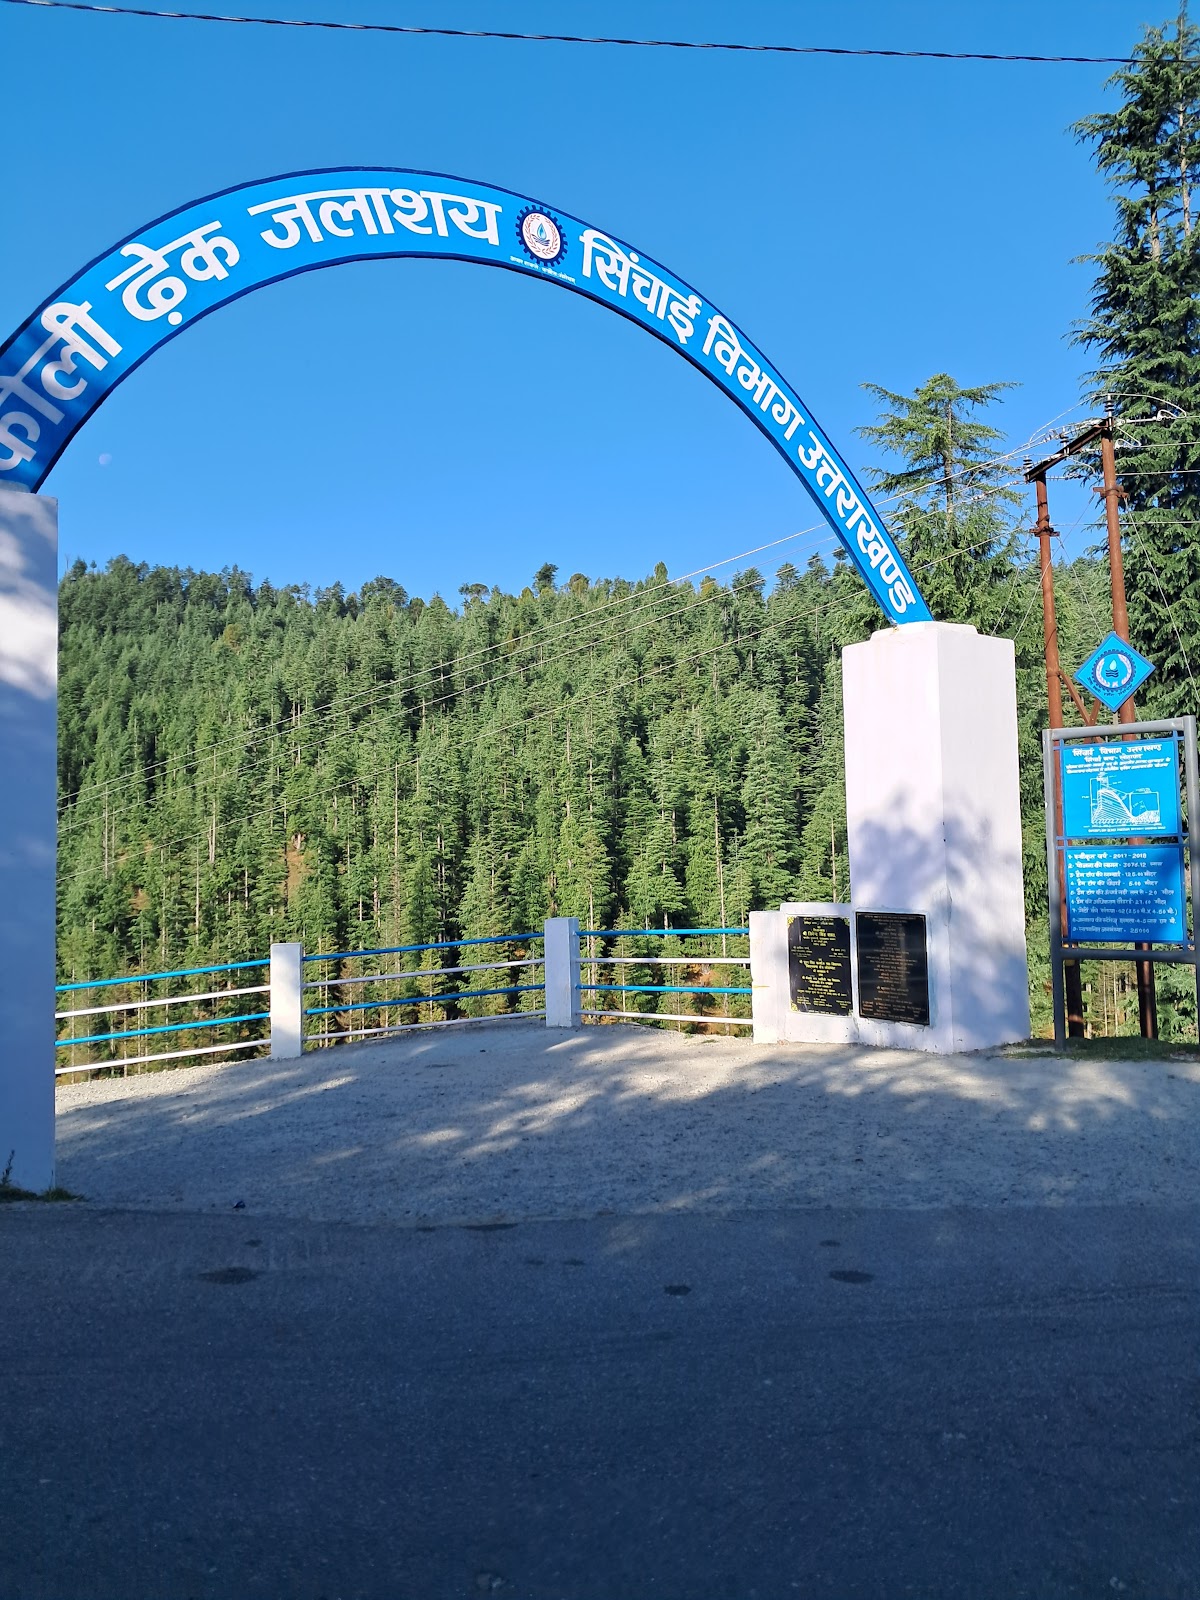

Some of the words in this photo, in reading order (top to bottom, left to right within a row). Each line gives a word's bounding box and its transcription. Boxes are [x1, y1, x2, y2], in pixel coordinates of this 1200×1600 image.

[247, 187, 503, 249] जलाशय
[579, 228, 703, 344] सिंचाई
[702, 314, 806, 441] विभाग
[797, 430, 916, 614] उत्तराखण्ड
[1072, 748, 1094, 756] सिंचाई
